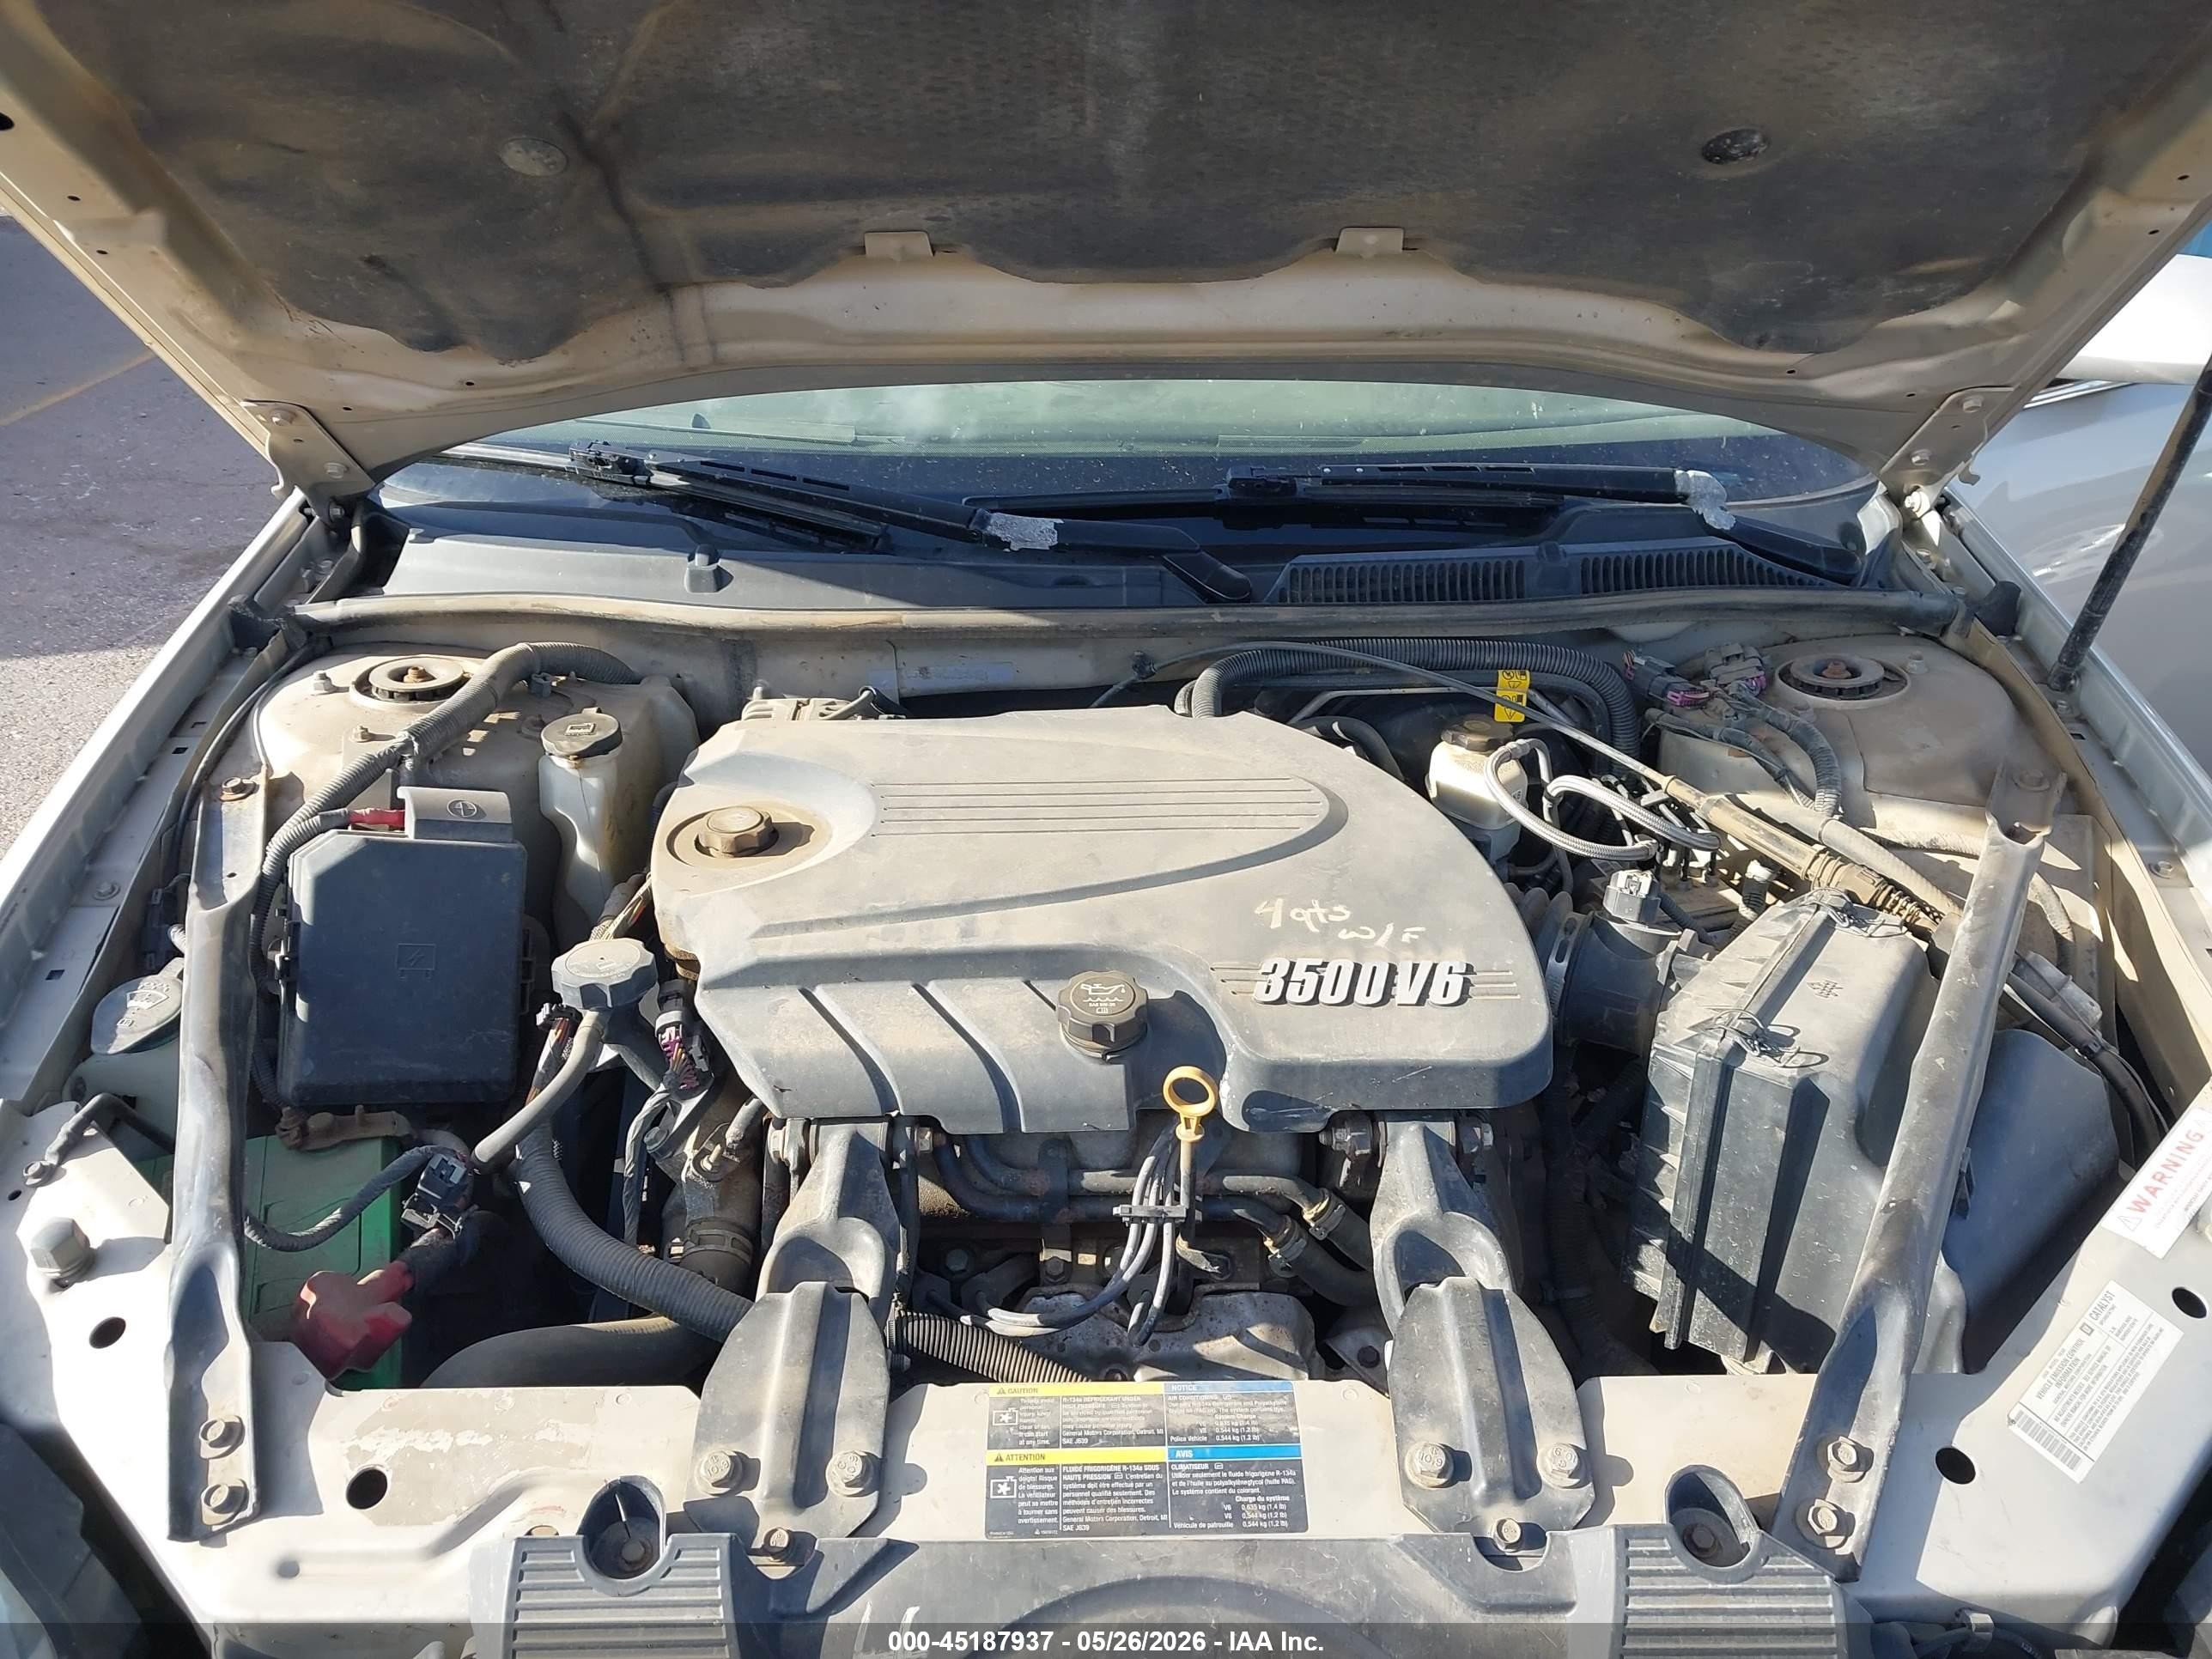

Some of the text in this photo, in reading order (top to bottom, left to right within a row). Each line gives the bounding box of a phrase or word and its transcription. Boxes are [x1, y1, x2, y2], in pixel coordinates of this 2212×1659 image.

[1253, 898, 1284, 929] 4
[2126, 1129, 2205, 1213] WARNING
[2087, 1289, 2115, 1322] CATALYST
[2035, 1377, 2053, 1401] VEHICLE
[2049, 1356, 2070, 1382] EMISSION
[2065, 1336, 2085, 1359] CONTROL
[2054, 1355, 2081, 1389] INFORMATION
[1176, 1449, 1194, 1458] AVIS
[1419, 1452, 1443, 1468] 10.9
